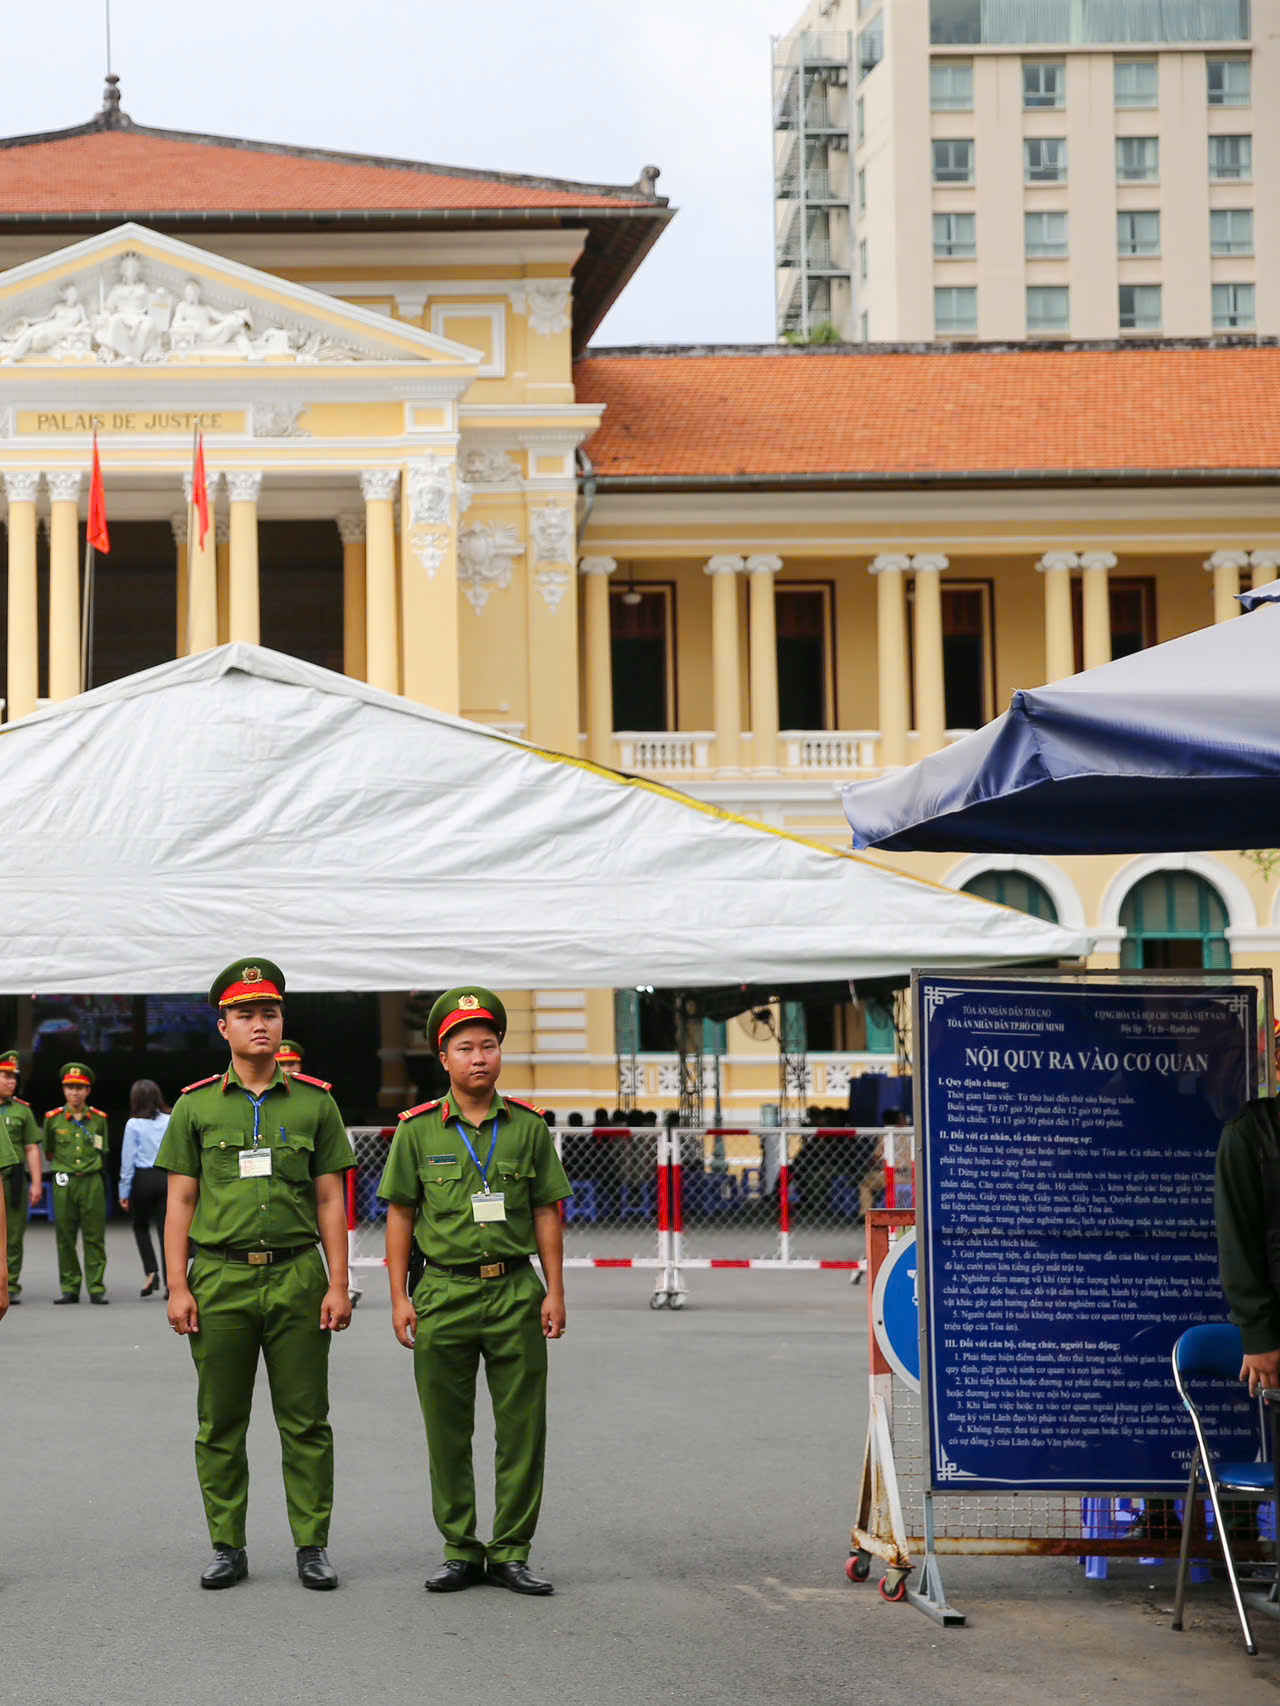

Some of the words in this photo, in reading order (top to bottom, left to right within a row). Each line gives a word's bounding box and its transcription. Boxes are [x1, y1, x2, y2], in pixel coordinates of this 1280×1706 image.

[38, 415, 104, 430] PALAIS
[112, 414, 136, 430] DE
[144, 414, 222, 430] JUSTCE
[965, 1046, 999, 1071] NỘI
[1004, 1051, 1044, 1072] QUY
[1049, 1051, 1075, 1069] RA
[1078, 1048, 1119, 1070] VÀO
[1124, 1052, 1151, 1071] CƠ
[1156, 1054, 1208, 1076] QUAN
[946, 1078, 962, 1088] Quy
[964, 1079, 981, 1088] định
[983, 1079, 1009, 1089] chung:
